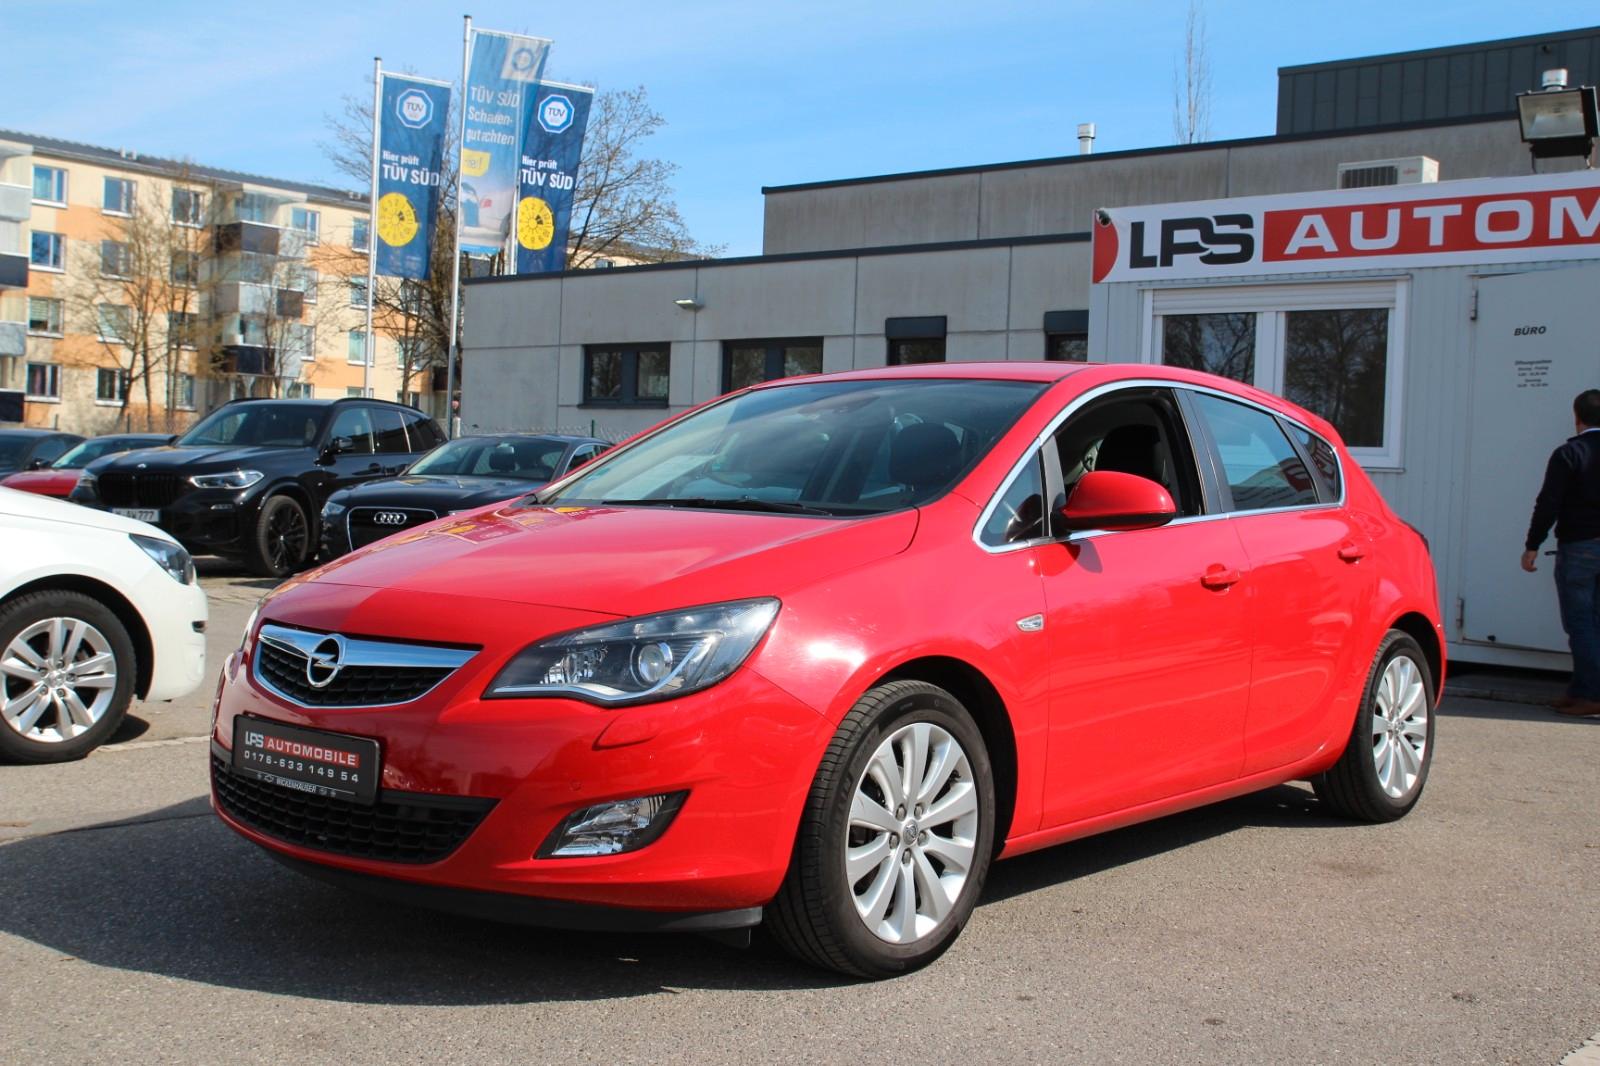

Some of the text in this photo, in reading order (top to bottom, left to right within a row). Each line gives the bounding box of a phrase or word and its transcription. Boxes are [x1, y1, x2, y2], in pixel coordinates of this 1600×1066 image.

[470, 86, 494, 104] TÜV
[548, 107, 566, 117] TÜV
[401, 154, 420, 165] prüft
[522, 155, 558, 170] Hier prüft
[383, 163, 440, 187] TÜV SÜD
[522, 168, 574, 190] TÜV SÜD
[1129, 194, 1600, 269] LPS AUTOM
[1514, 325, 1547, 336] BÜRO
[245, 731, 357, 765] LPS AUTOMOBILE
[244, 750, 359, 783] 0176-633 149 54
